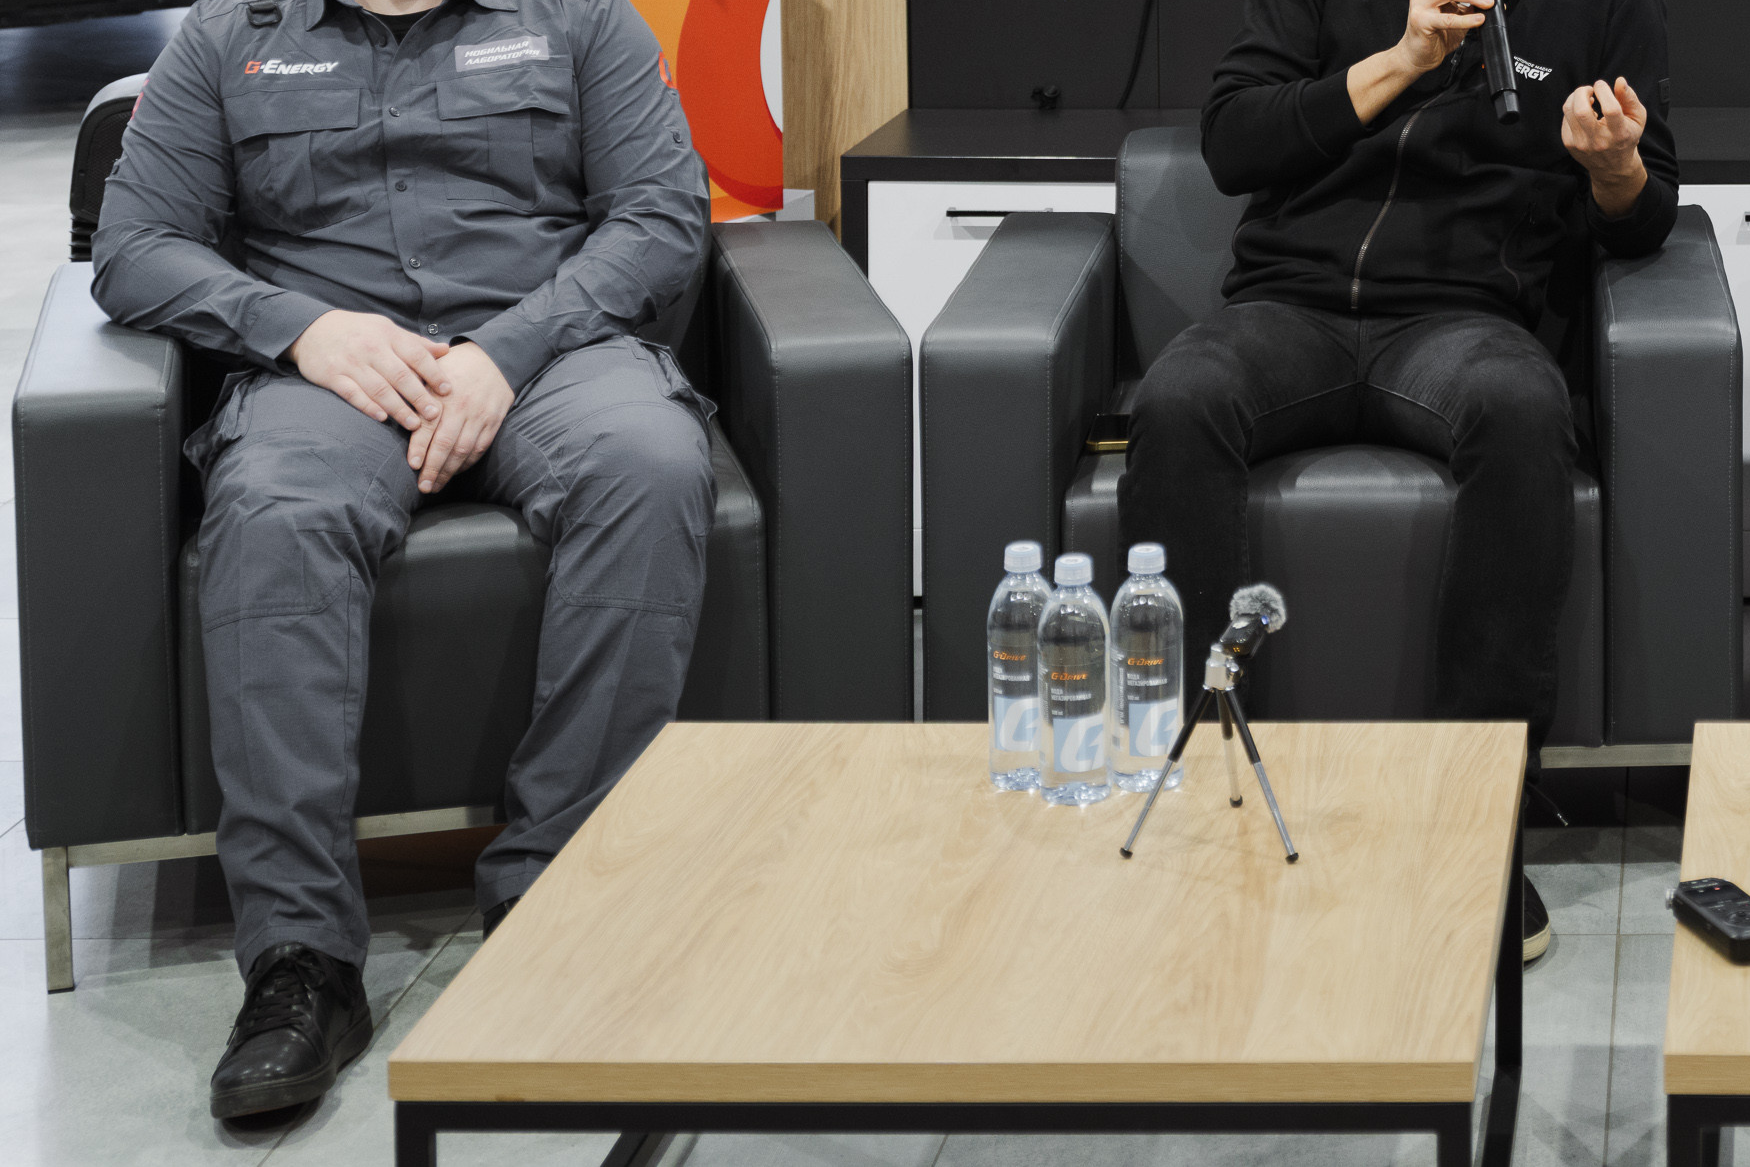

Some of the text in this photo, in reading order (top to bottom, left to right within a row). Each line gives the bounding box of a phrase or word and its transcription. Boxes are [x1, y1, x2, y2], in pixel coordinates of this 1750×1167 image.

[464, 40, 529, 58] МОБИЛЬНАЯ
[464, 49, 541, 66] ЛАБОРАТОРИЯ
[1514, 61, 1550, 81] ERGY
